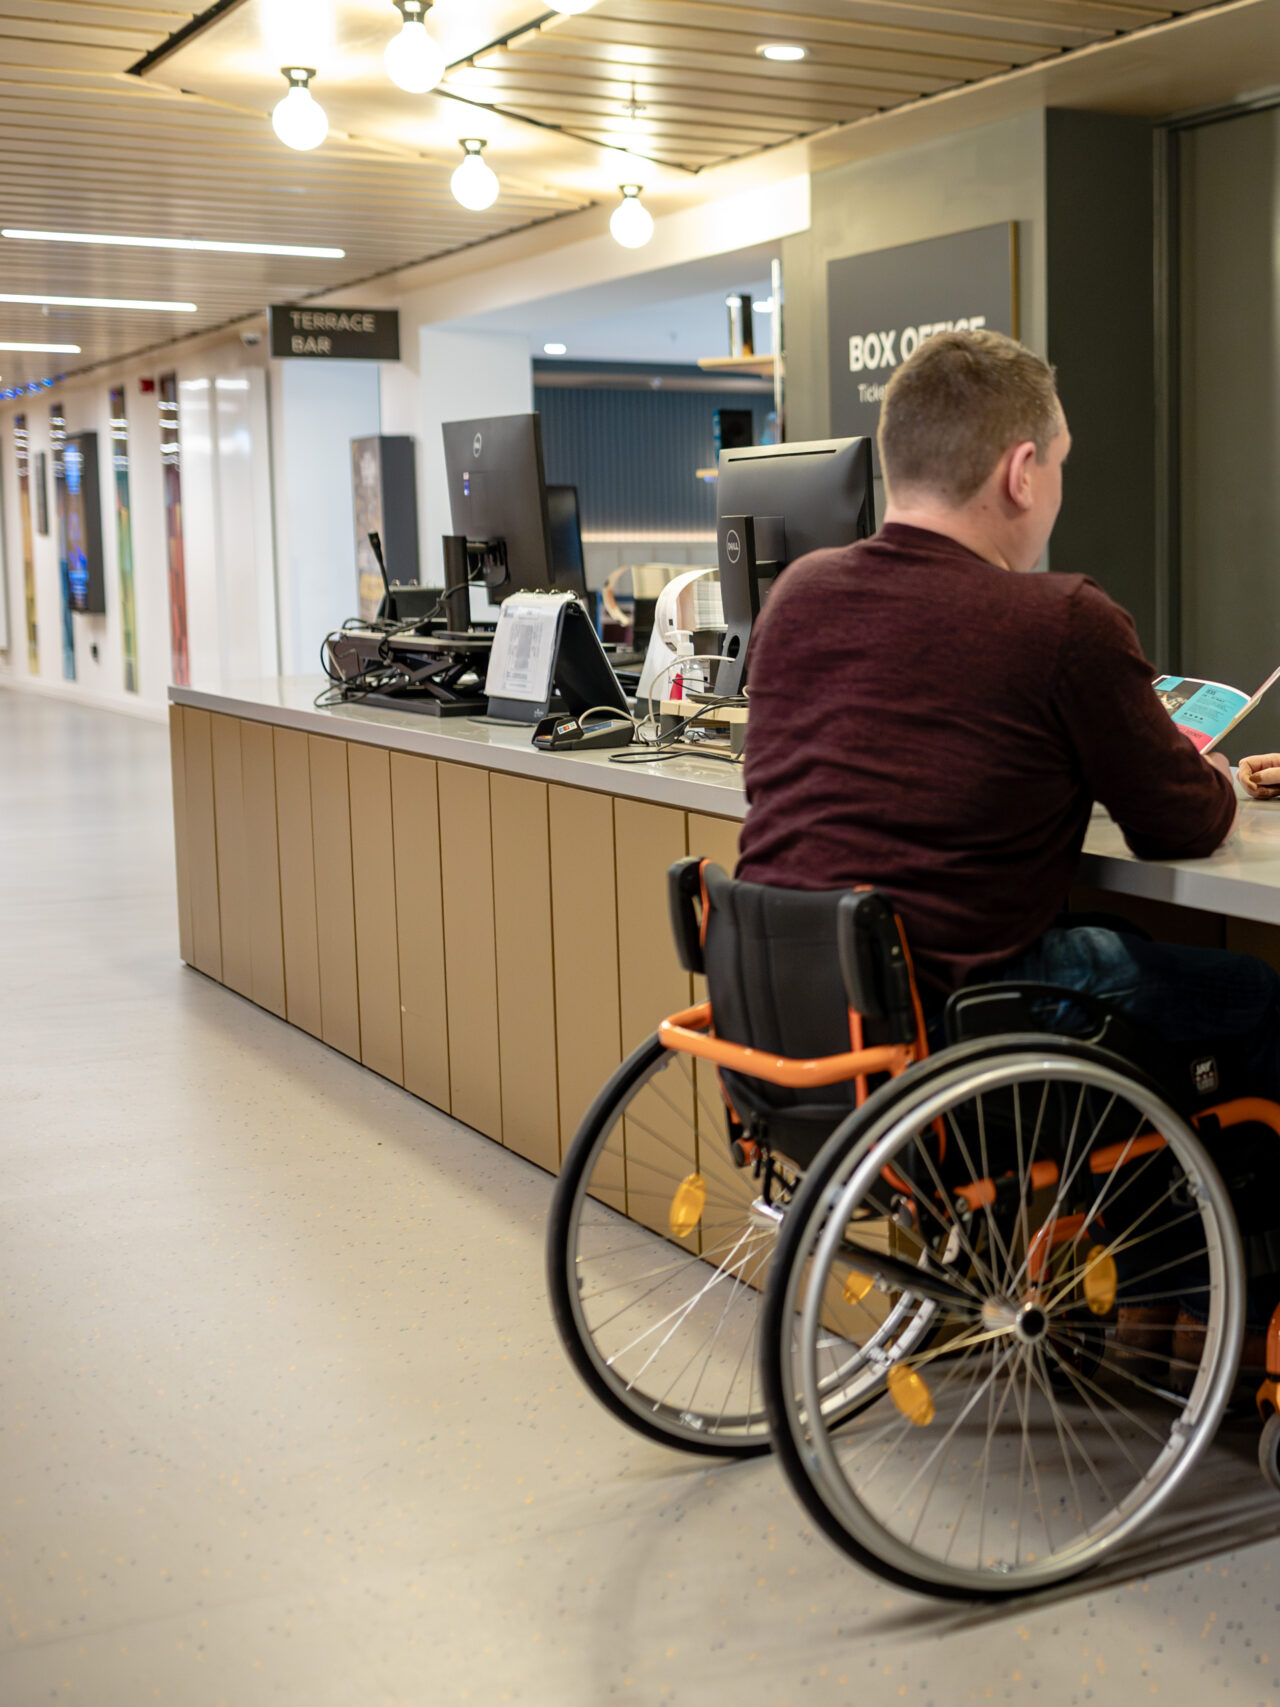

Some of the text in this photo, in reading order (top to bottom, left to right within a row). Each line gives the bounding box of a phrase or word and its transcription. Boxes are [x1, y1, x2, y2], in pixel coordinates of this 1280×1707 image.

[290, 311, 376, 333] TERRACE
[291, 335, 332, 355] BAR
[849, 329, 897, 372] BOX
